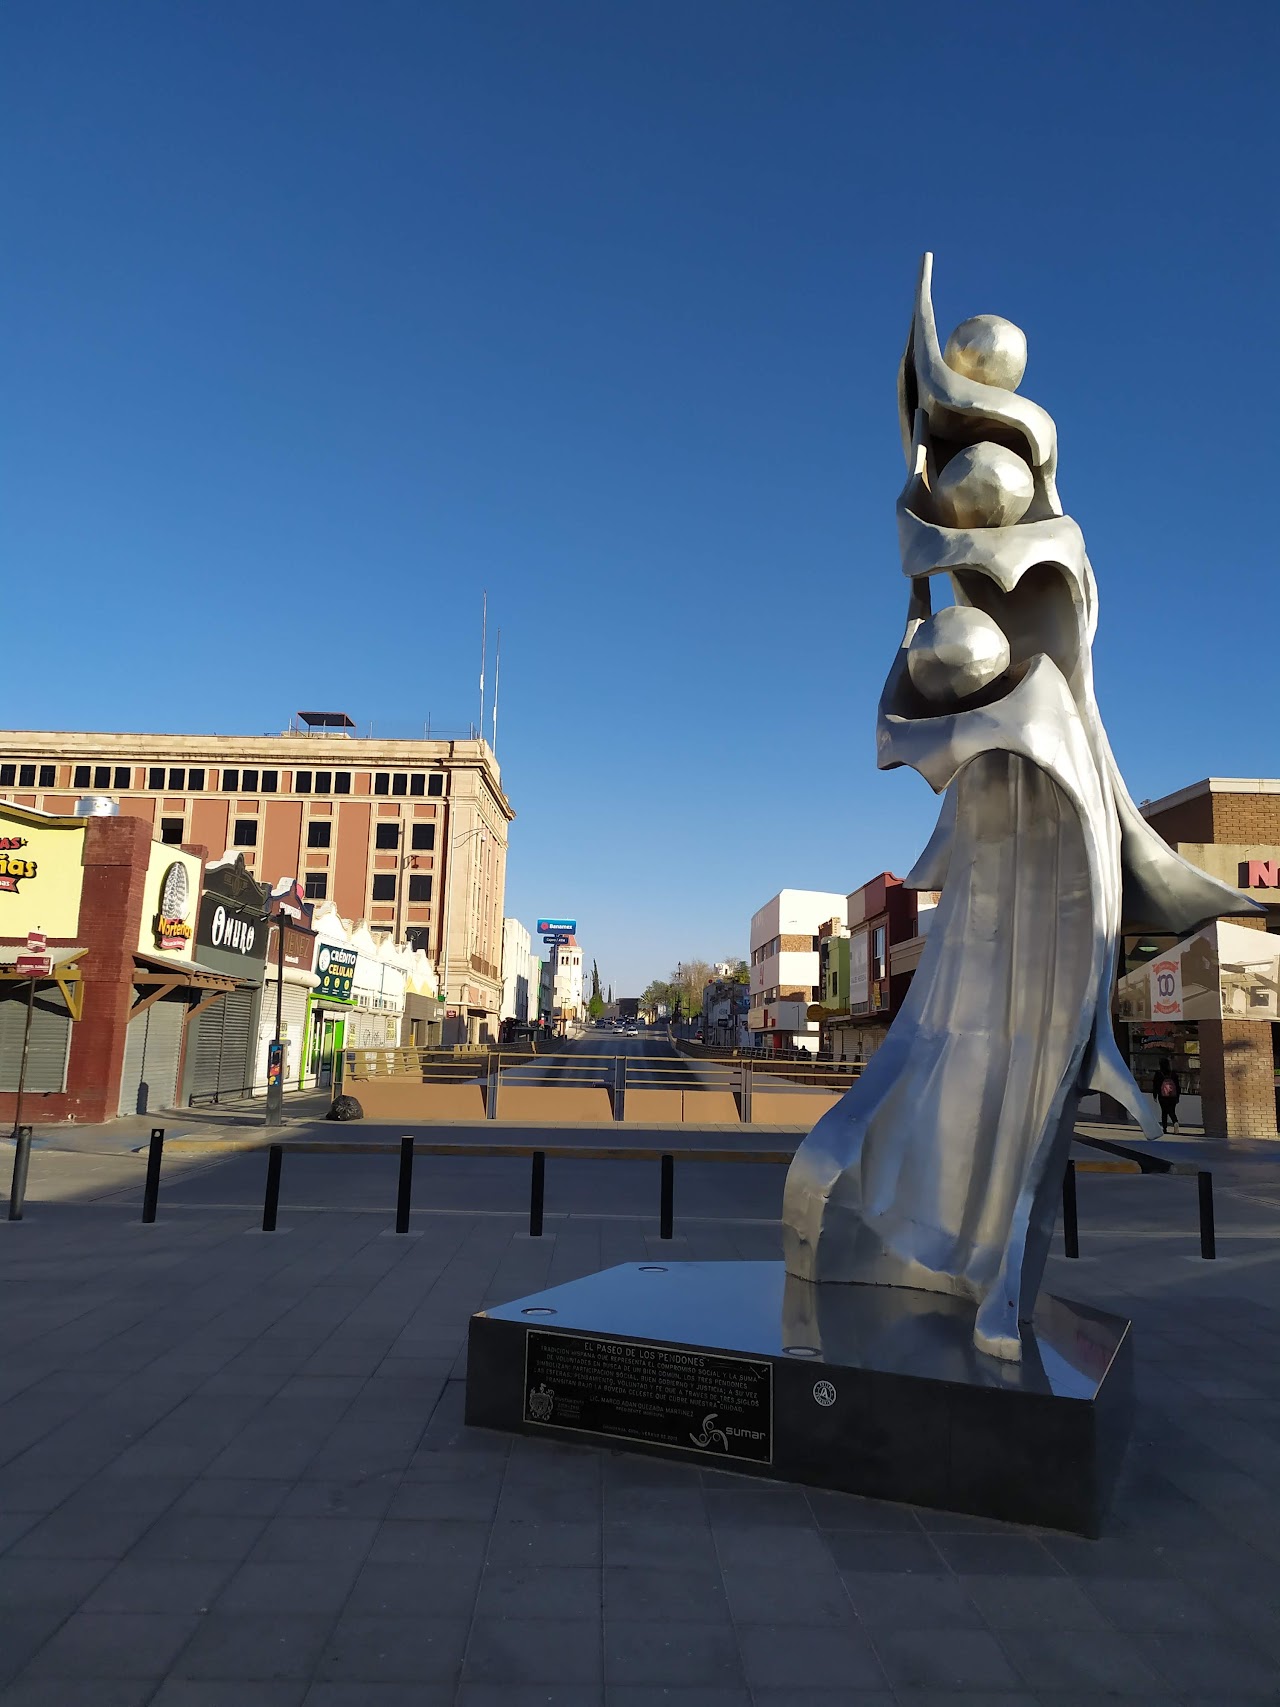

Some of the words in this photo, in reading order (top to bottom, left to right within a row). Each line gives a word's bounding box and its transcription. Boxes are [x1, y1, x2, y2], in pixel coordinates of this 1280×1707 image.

[330, 948, 356, 965] CRÉDITO
[328, 964, 354, 978] CELULAR
[584, 1342, 593, 1351] EL
[597, 1344, 622, 1355] PASEO
[626, 1348, 635, 1357] DE
[640, 1350, 655, 1360] LOS
[658, 1352, 705, 1367] PENDONES
[546, 1353, 553, 1361] DE
[624, 1364, 630, 1372] DE
[633, 1366, 641, 1374] UN
[643, 1368, 656, 1376] BIEN
[684, 1374, 695, 1382] LOS
[698, 1375, 712, 1384] TRES
[715, 1379, 748, 1390] PENDONES
[611, 1356, 646, 1366] REPRESENTA
[657, 1362, 697, 1374] COMPROMISO
[698, 1368, 720, 1378] SOCIAL
[729, 1372, 737, 1380] LA
[740, 1375, 758, 1383] SUMA
[578, 1380, 592, 1388] BAJO
[628, 1388, 654, 1399] CELESTE
[655, 1392, 666, 1400] QUE
[668, 1395, 688, 1404] CUBRE
[690, 1398, 718, 1408] NUESTRA
[617, 1379, 648, 1390] VOLUNTAD
[664, 1387, 676, 1395] QUE
[710, 1393, 717, 1401] DE
[720, 1395, 735, 1404] TRES
[736, 1398, 760, 1407] SIGLOS
[641, 1375, 656, 1383] BUEN
[658, 1378, 688, 1388] GOBIERNO
[746, 1391, 758, 1399] VEZ
[601, 1397, 620, 1405] MARCO
[638, 1402, 664, 1412] QUEZADA
[666, 1407, 694, 1418] MARTINEZ
[726, 1426, 766, 1440] sumar
